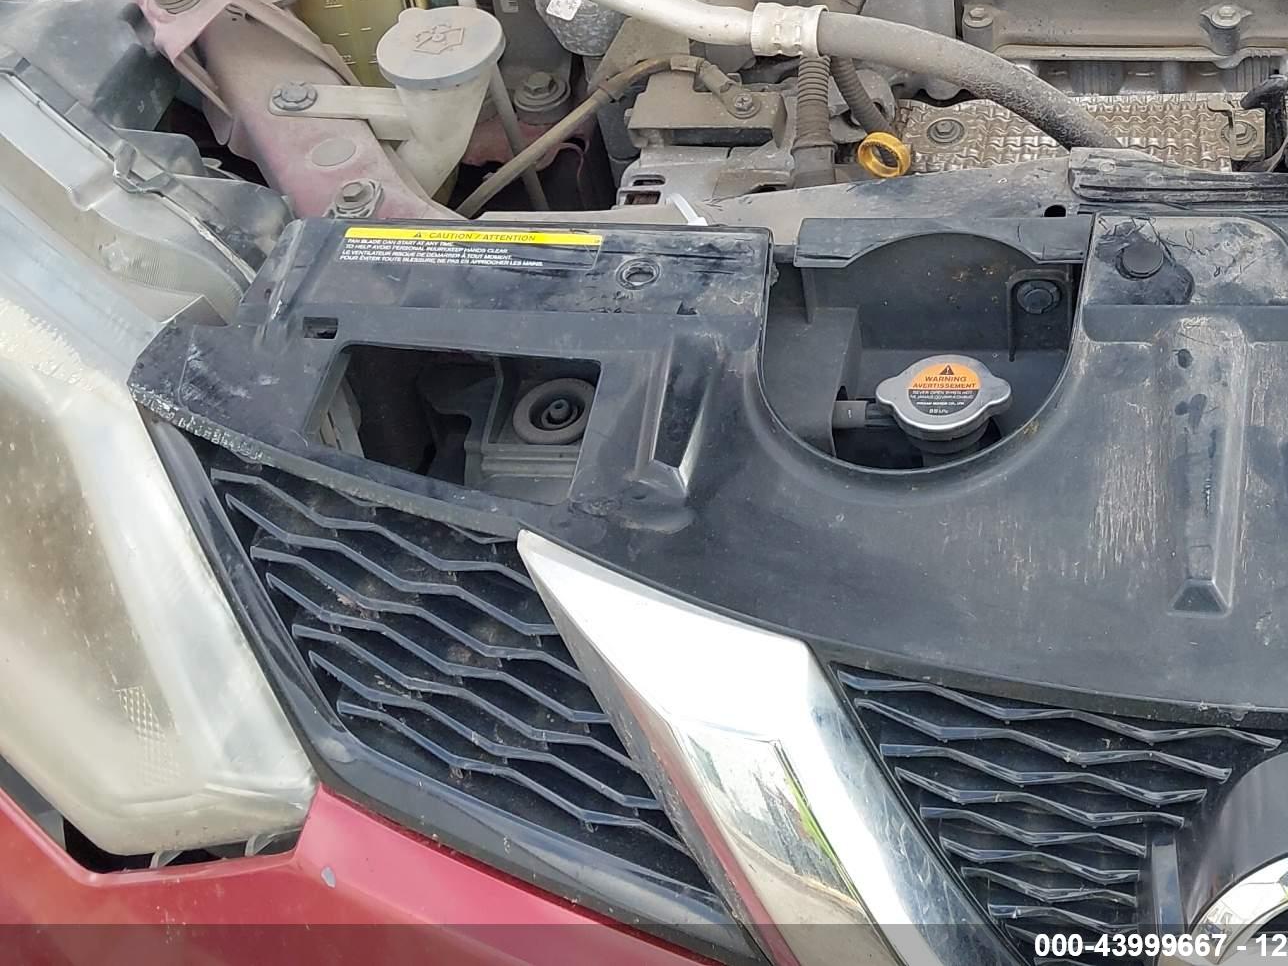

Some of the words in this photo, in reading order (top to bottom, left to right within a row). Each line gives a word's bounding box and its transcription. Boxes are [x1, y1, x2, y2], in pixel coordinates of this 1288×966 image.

[428, 232, 473, 240] CAUTION
[482, 233, 536, 242] ATTENTION
[925, 375, 968, 383] WARNING
